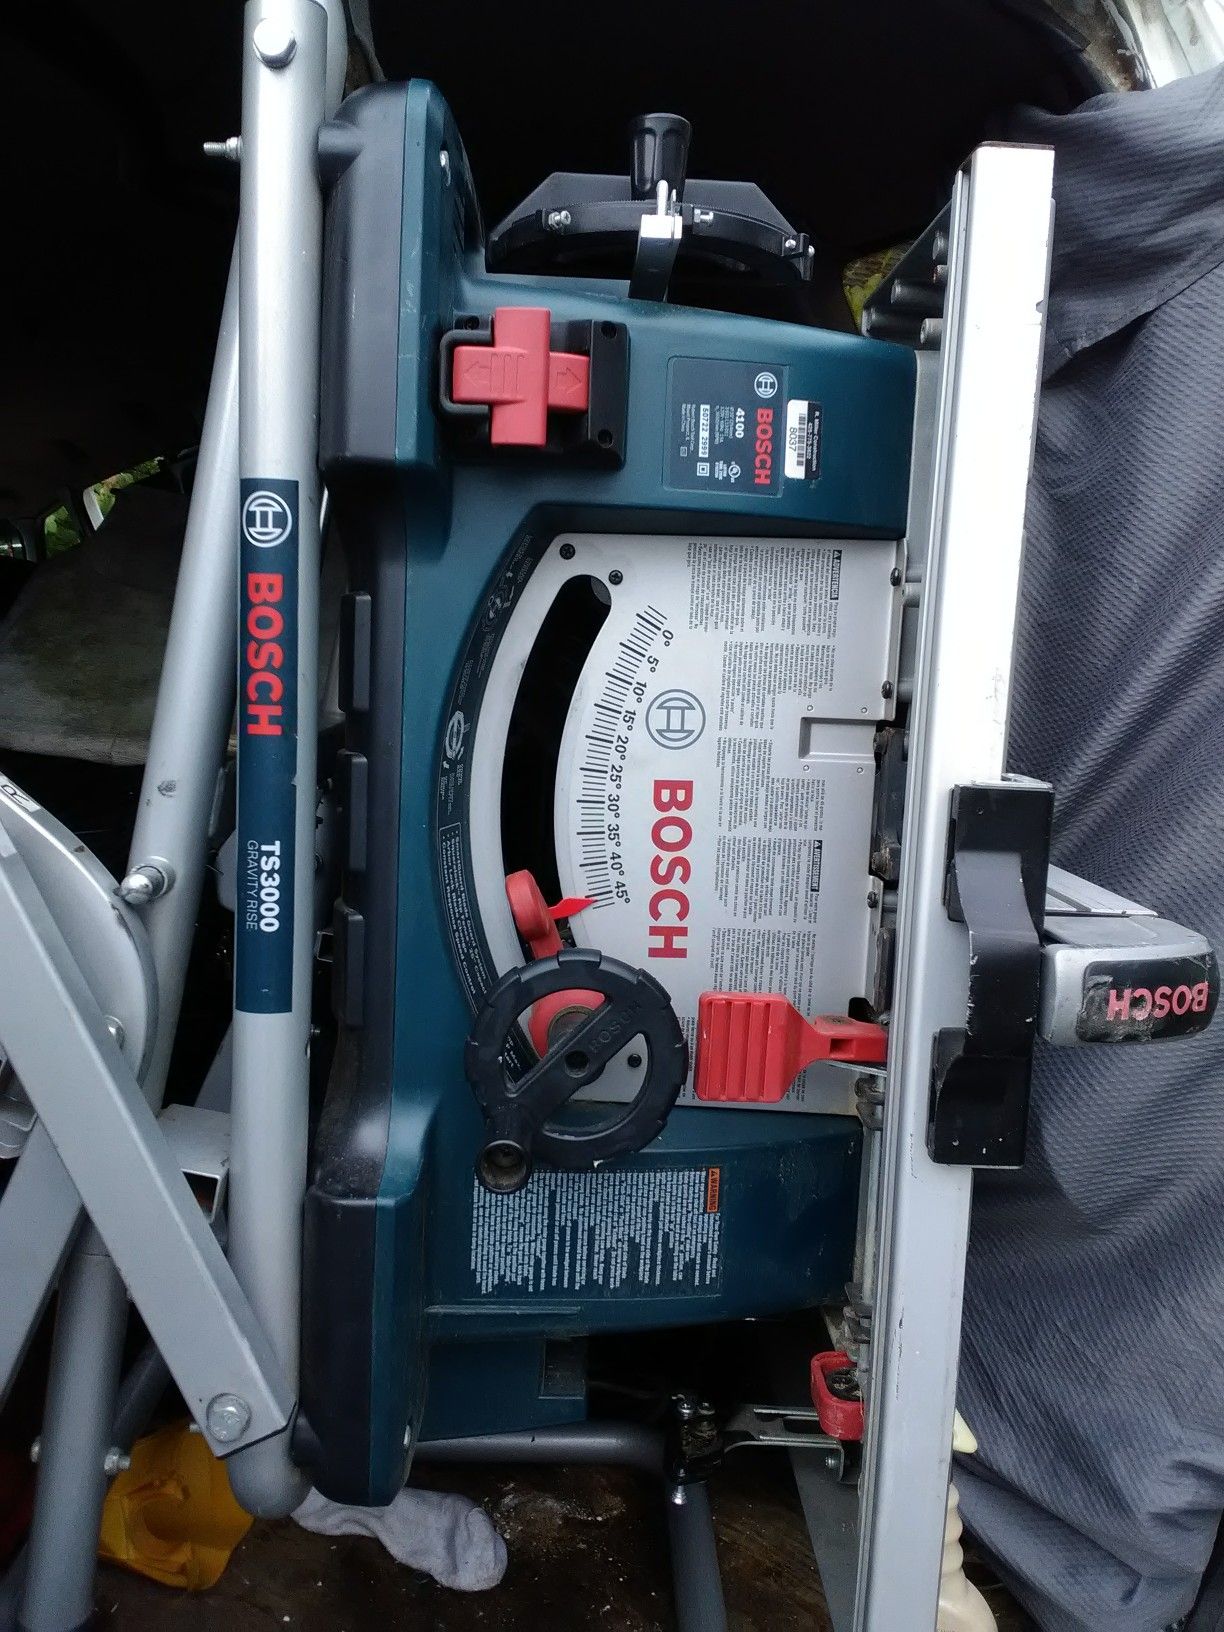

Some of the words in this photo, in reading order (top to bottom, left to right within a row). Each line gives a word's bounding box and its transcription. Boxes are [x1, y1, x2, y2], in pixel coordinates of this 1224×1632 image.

[735, 408, 745, 438] 4100
[754, 408, 773, 484] BOSCH
[788, 426, 798, 452] 8037
[830, 559, 840, 598] ADVERTENCIA
[661, 629, 674, 646] 0°
[246, 572, 283, 736] BOSCH
[646, 655, 660, 672] 5°
[633, 681, 647, 703] 10°
[622, 709, 636, 730] 15°
[615, 735, 629, 760] 20°
[609, 765, 623, 789] 25°
[607, 794, 621, 818] 30°
[608, 824, 621, 847] 35°
[246, 840, 260, 897] GRAVITY
[609, 852, 624, 876] 40°
[648, 779, 694, 958] BOSCH
[258, 840, 280, 932] TS3000
[614, 880, 631, 904] 45°
[246, 899, 258, 931] RISE
[450, 893, 458, 917] Blade
[457, 920, 467, 953] Change
[446, 886, 456, 930] Response
[454, 932, 464, 960] Speed
[462, 962, 475, 994] Control
[473, 948, 486, 979] System
[1107, 981, 1209, 1021] BOSCH
[708, 1178, 718, 1210] WARNING
